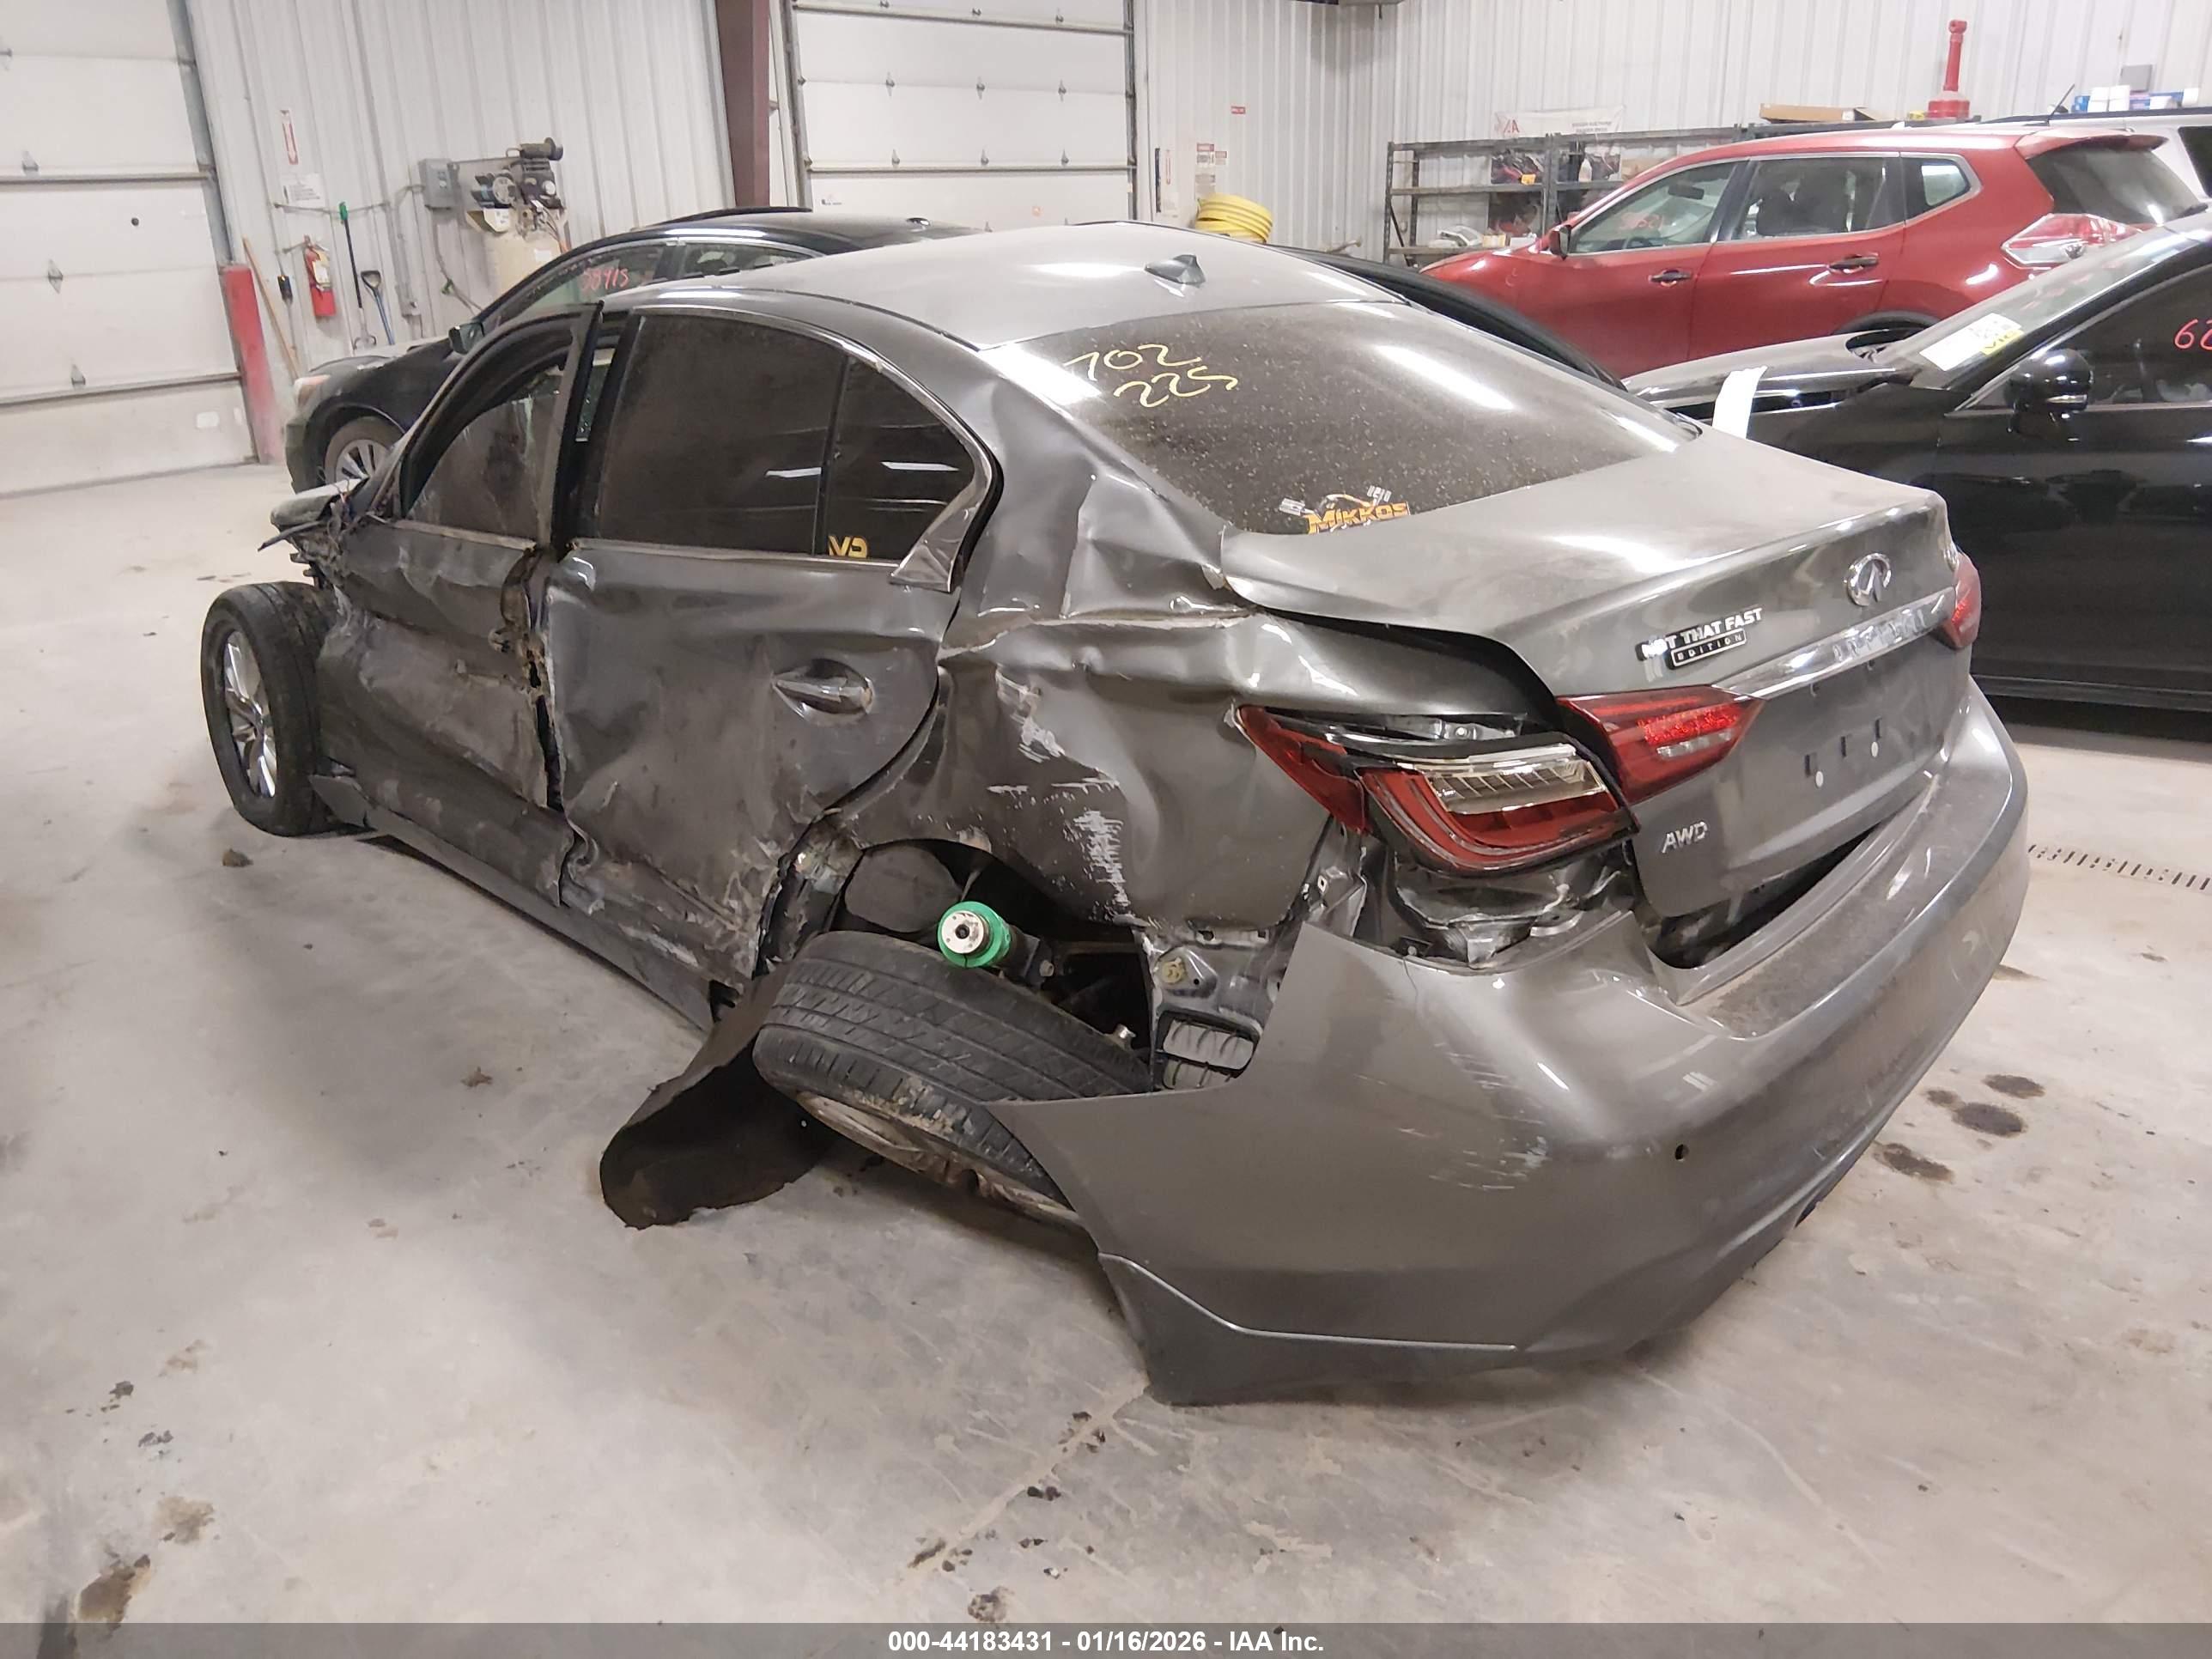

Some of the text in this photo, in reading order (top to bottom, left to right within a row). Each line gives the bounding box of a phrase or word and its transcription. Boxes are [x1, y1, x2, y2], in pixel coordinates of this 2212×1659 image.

[1113, 366, 1238, 408] 225
[1680, 621, 1723, 643] THAT
[1725, 608, 1763, 630] FAST
[1677, 634, 1742, 660] EDITION
[1662, 821, 1708, 854] AWD
